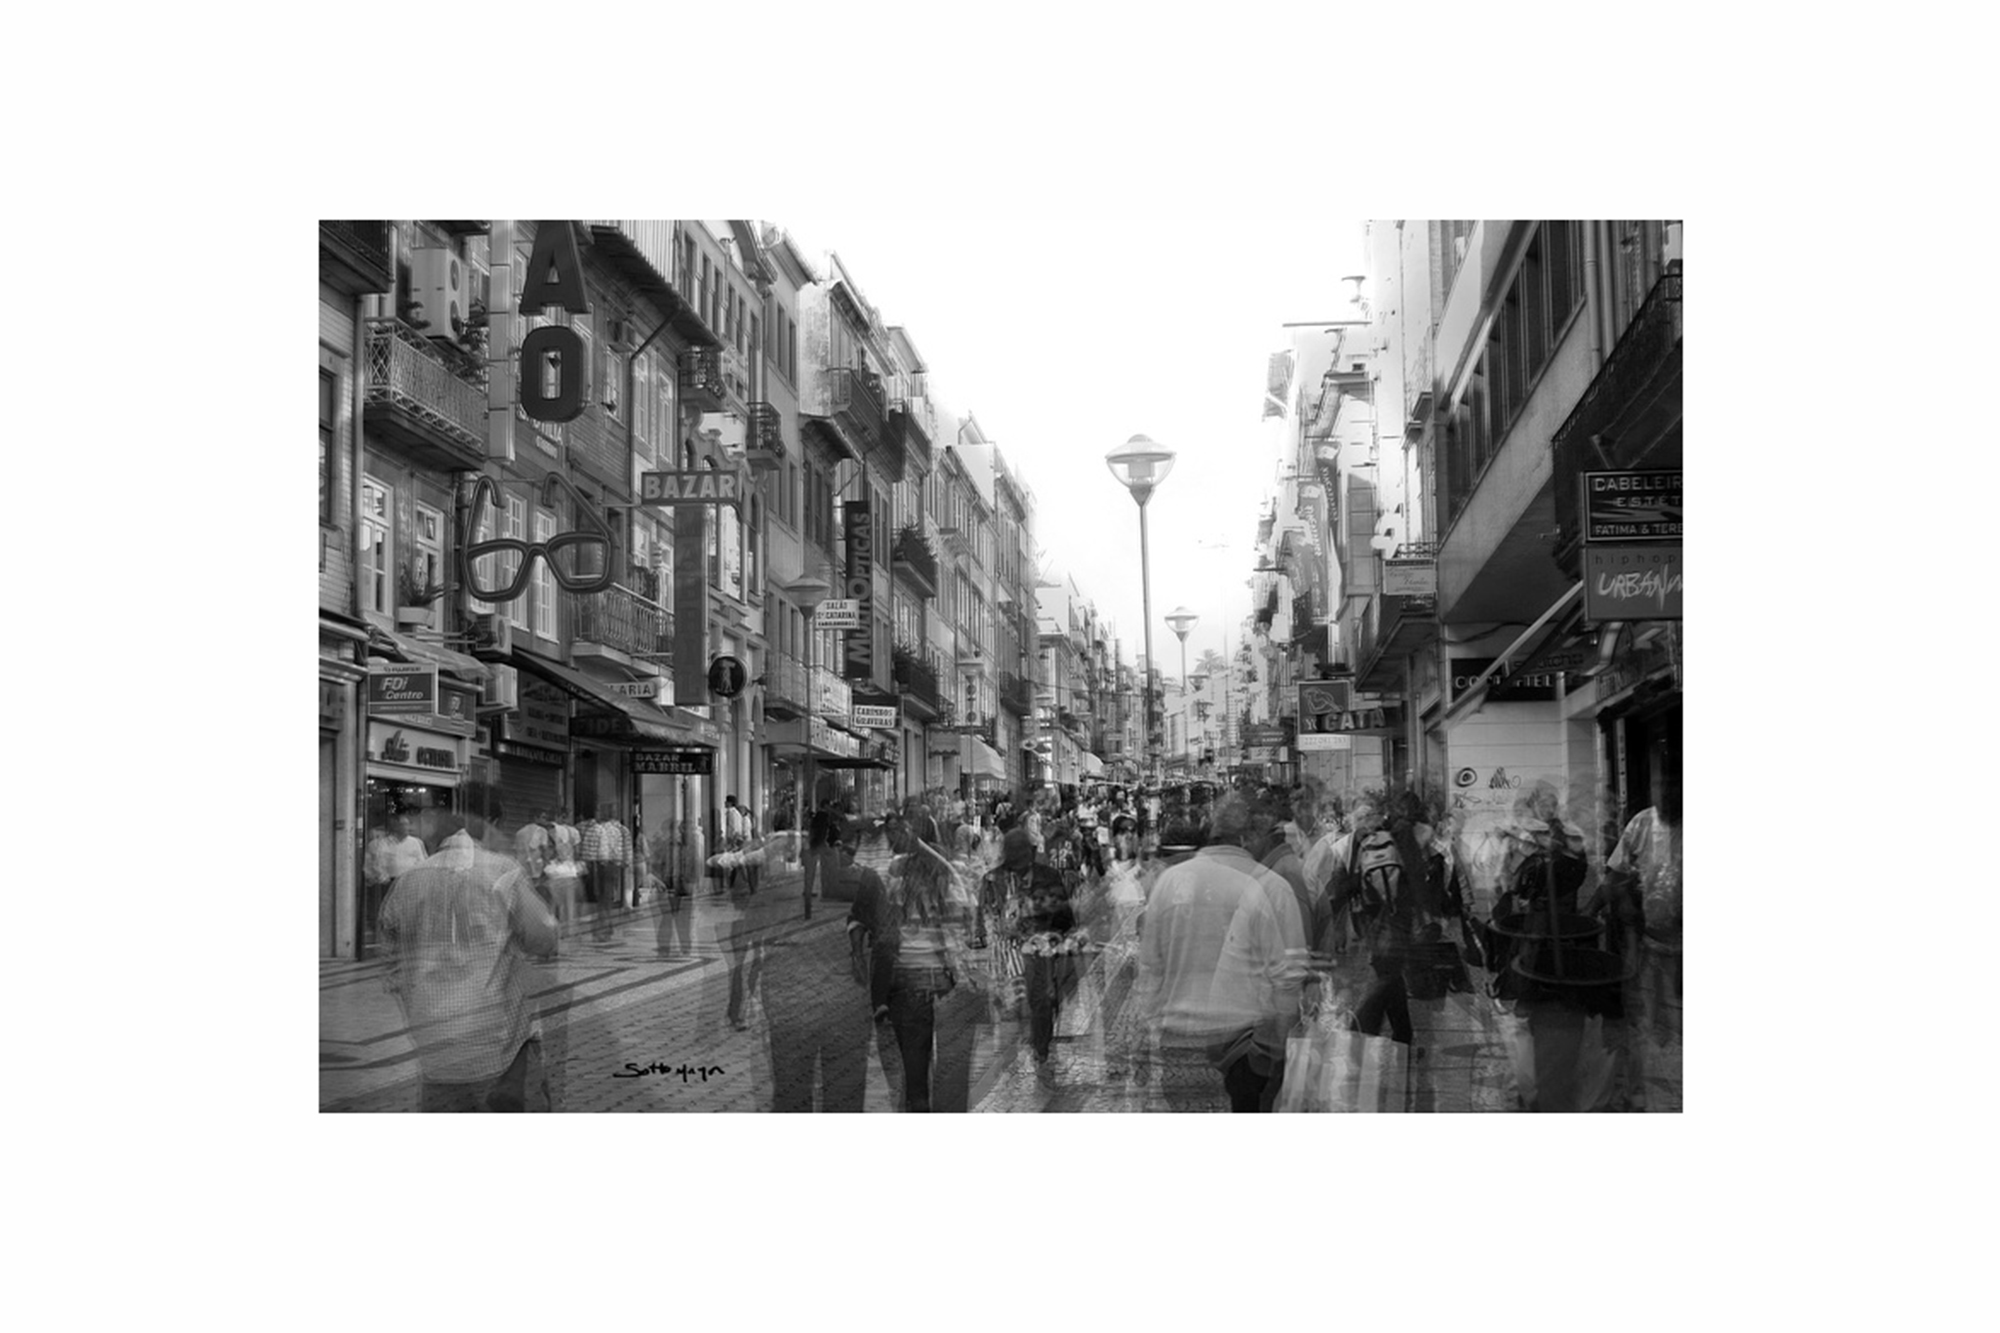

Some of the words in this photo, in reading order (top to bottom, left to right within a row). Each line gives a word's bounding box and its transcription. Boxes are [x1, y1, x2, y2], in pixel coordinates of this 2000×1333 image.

[643, 474, 736, 499] BAZAR
[1595, 524, 1638, 535] FATIMA
[1641, 524, 1650, 534] &
[826, 611, 856, 620] CATARINA
[386, 691, 424, 700] Centro
[855, 717, 893, 726] GRAVURAS
[635, 753, 680, 762] BAZAR
[634, 761, 696, 773] MABRIL
